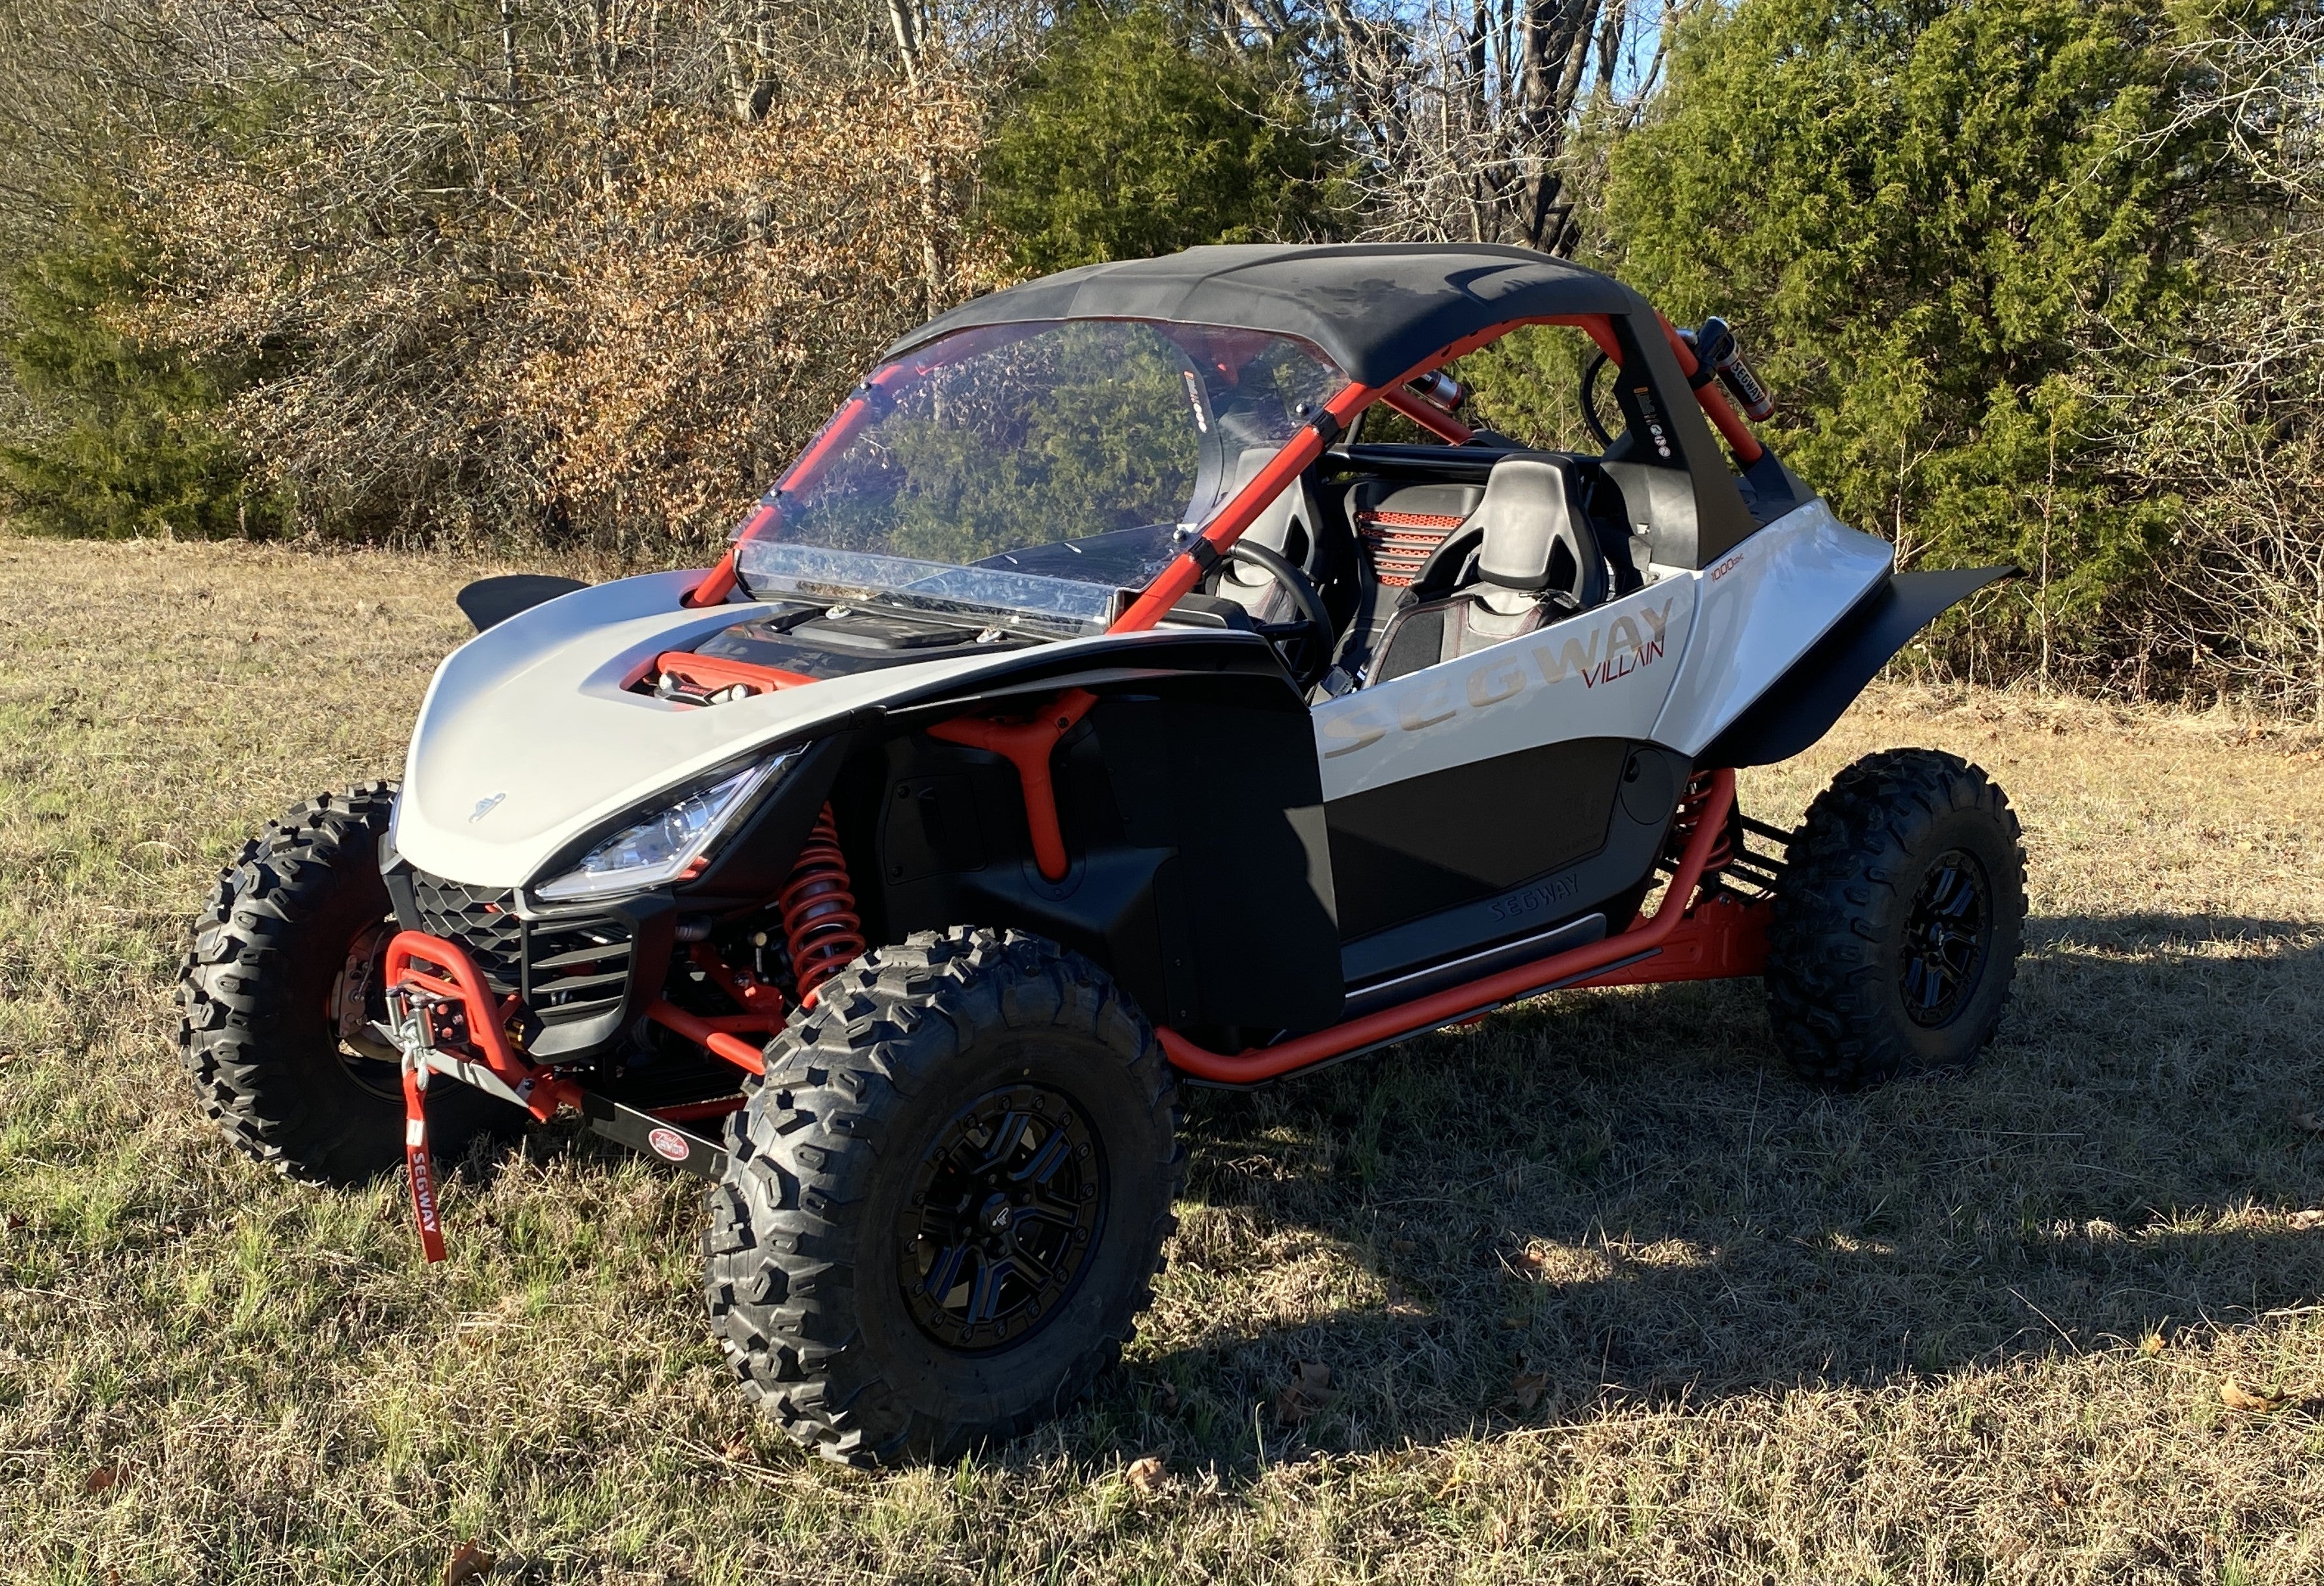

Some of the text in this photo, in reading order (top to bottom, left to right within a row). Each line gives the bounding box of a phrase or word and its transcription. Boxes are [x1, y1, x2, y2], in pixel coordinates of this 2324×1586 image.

[1731, 360, 1764, 401] SEGWAY
[1322, 596, 1673, 759] SEGWAY
[1580, 634, 1665, 689] VILLAIN
[1490, 872, 1580, 922] SEGWAY
[412, 1152, 437, 1233] SEGWAY
